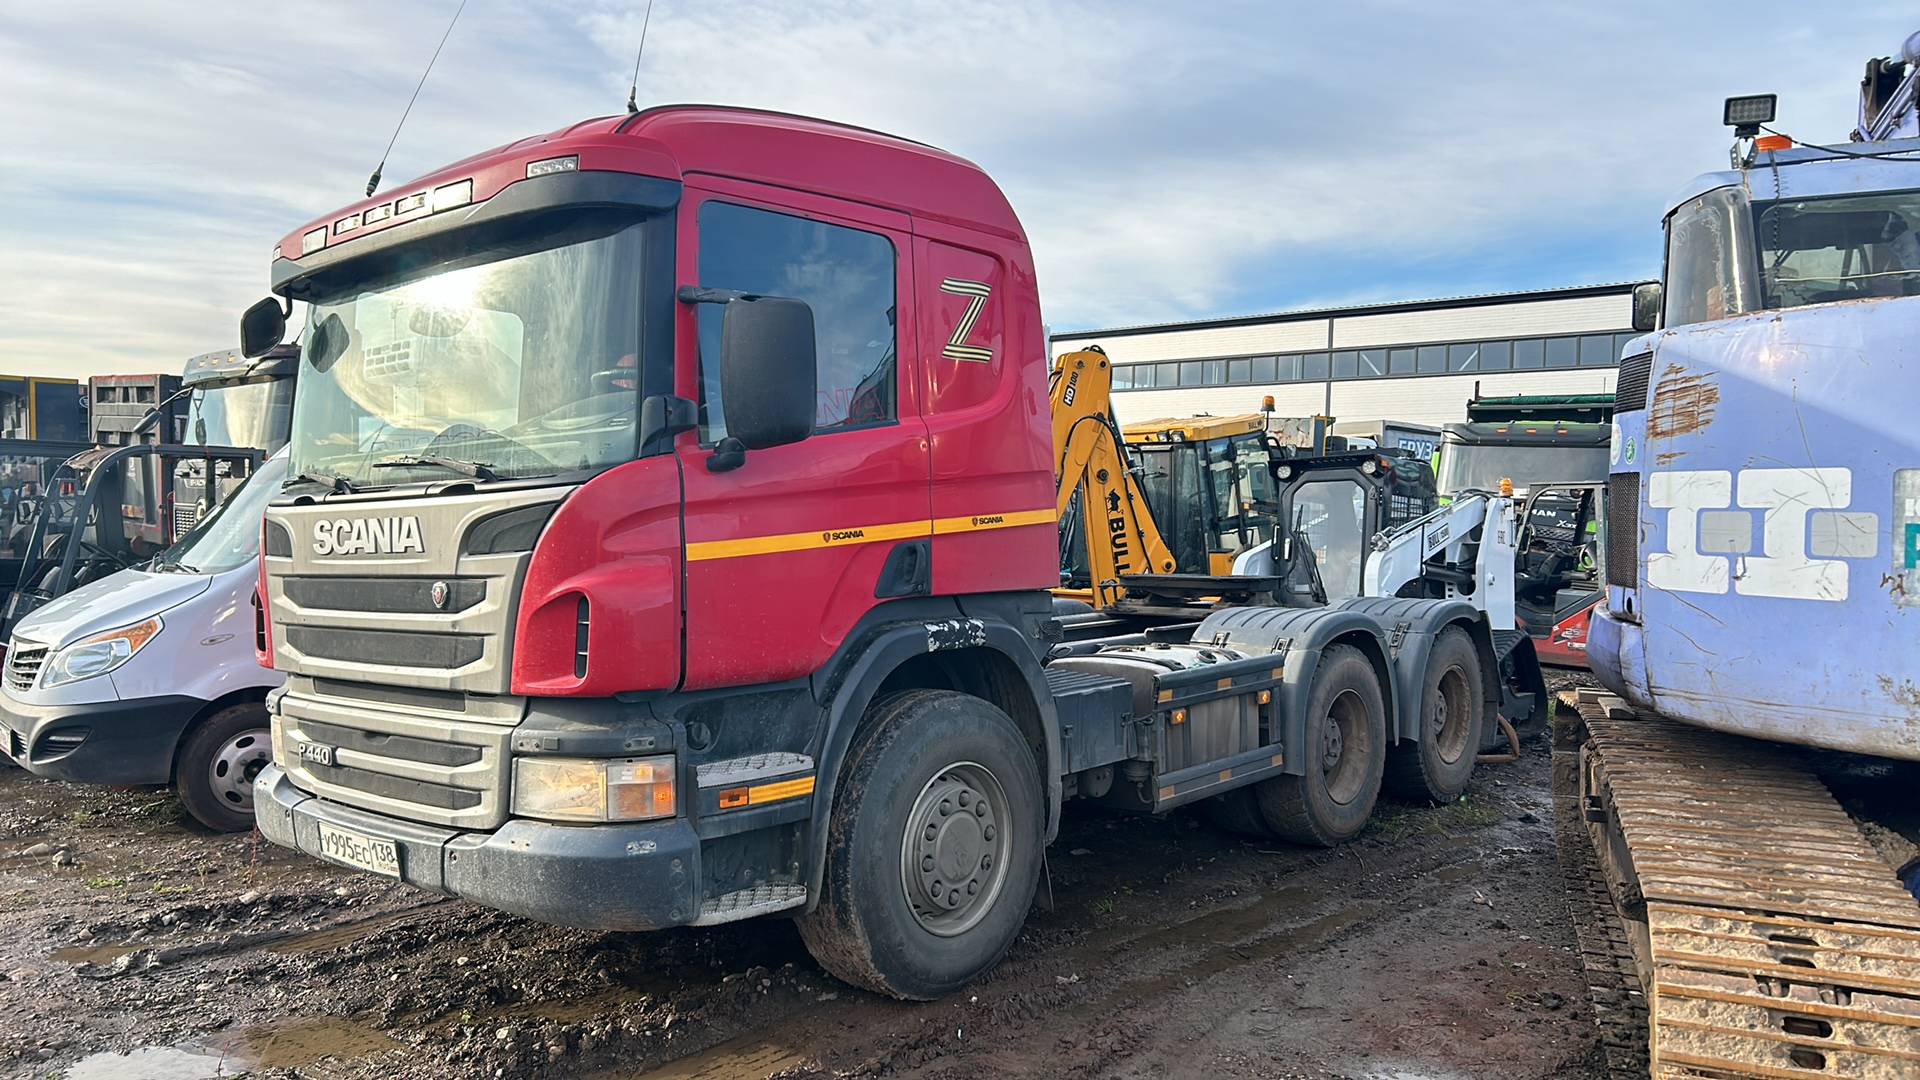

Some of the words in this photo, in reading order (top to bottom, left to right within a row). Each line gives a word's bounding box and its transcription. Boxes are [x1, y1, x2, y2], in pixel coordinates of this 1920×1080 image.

[940, 277, 993, 363] Z
[1064, 387, 1075, 405] HD
[978, 515, 1004, 525] SCANIA
[312, 516, 425, 555] SCANIA
[832, 529, 865, 541] SCANIA
[1109, 517, 1130, 577] BULL
[371, 842, 395, 863] 138
